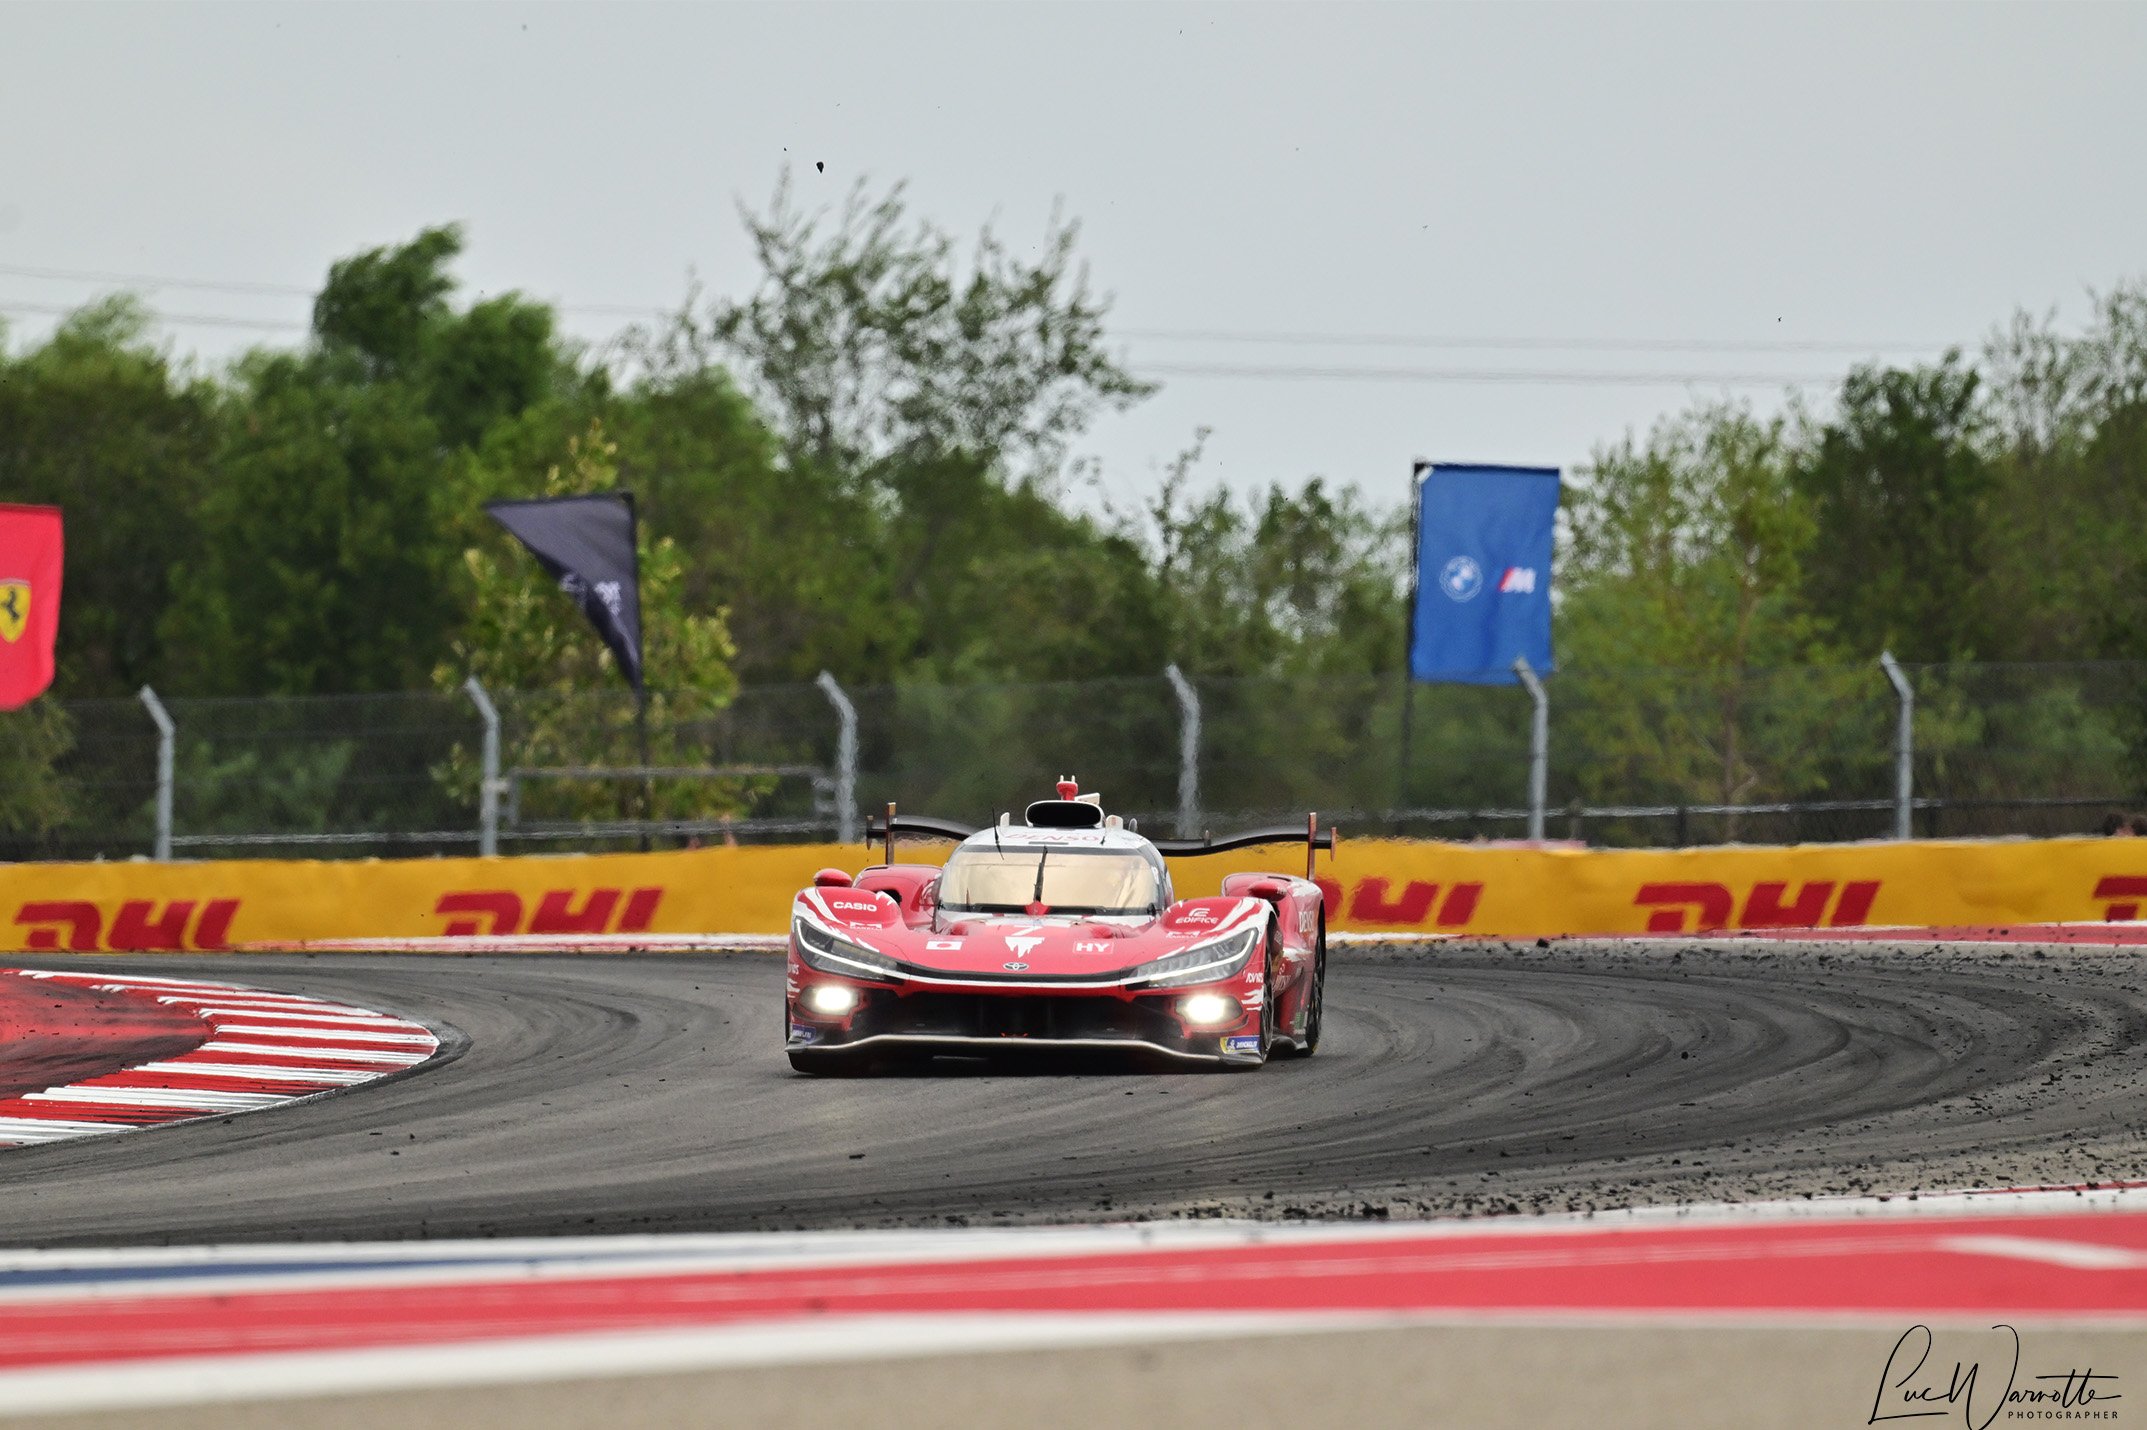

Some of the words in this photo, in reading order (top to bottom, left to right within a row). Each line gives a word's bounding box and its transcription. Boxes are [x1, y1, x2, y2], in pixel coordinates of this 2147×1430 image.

[14, 898, 241, 950] DHL
[436, 886, 663, 936] DHL
[833, 901, 878, 912] CASIO
[1316, 877, 1483, 926] HL
[1634, 881, 1882, 932] DHL
[1076, 942, 1110, 952] HY
